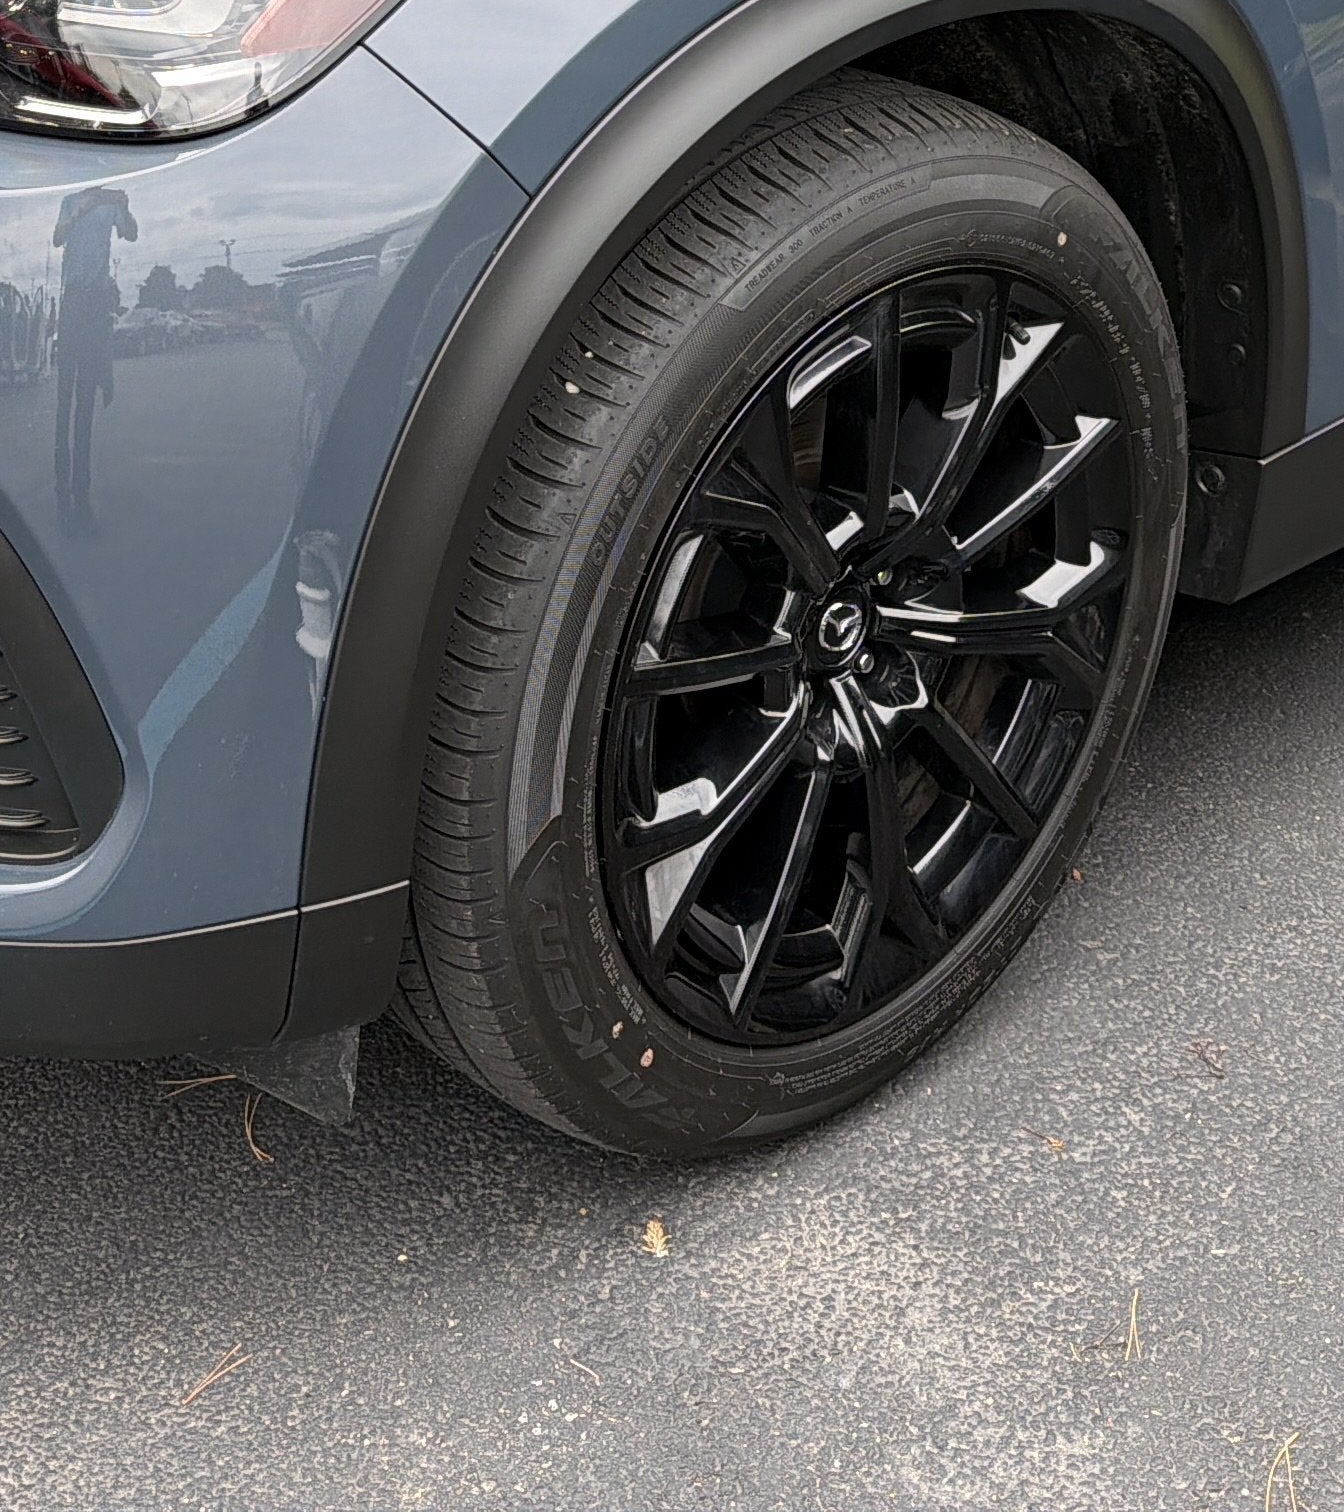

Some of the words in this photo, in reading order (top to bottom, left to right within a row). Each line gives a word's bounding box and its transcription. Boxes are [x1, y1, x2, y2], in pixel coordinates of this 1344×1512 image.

[744, 253, 785, 292] TREADWEAR
[788, 239, 804, 255] 300
[809, 211, 844, 238] TRACTION
[846, 206, 854, 215] A
[858, 179, 906, 207] TEMPERATURE
[910, 177, 917, 186] A
[590, 414, 670, 567] OUTSIDE
[531, 906, 699, 1131] FALKEN
